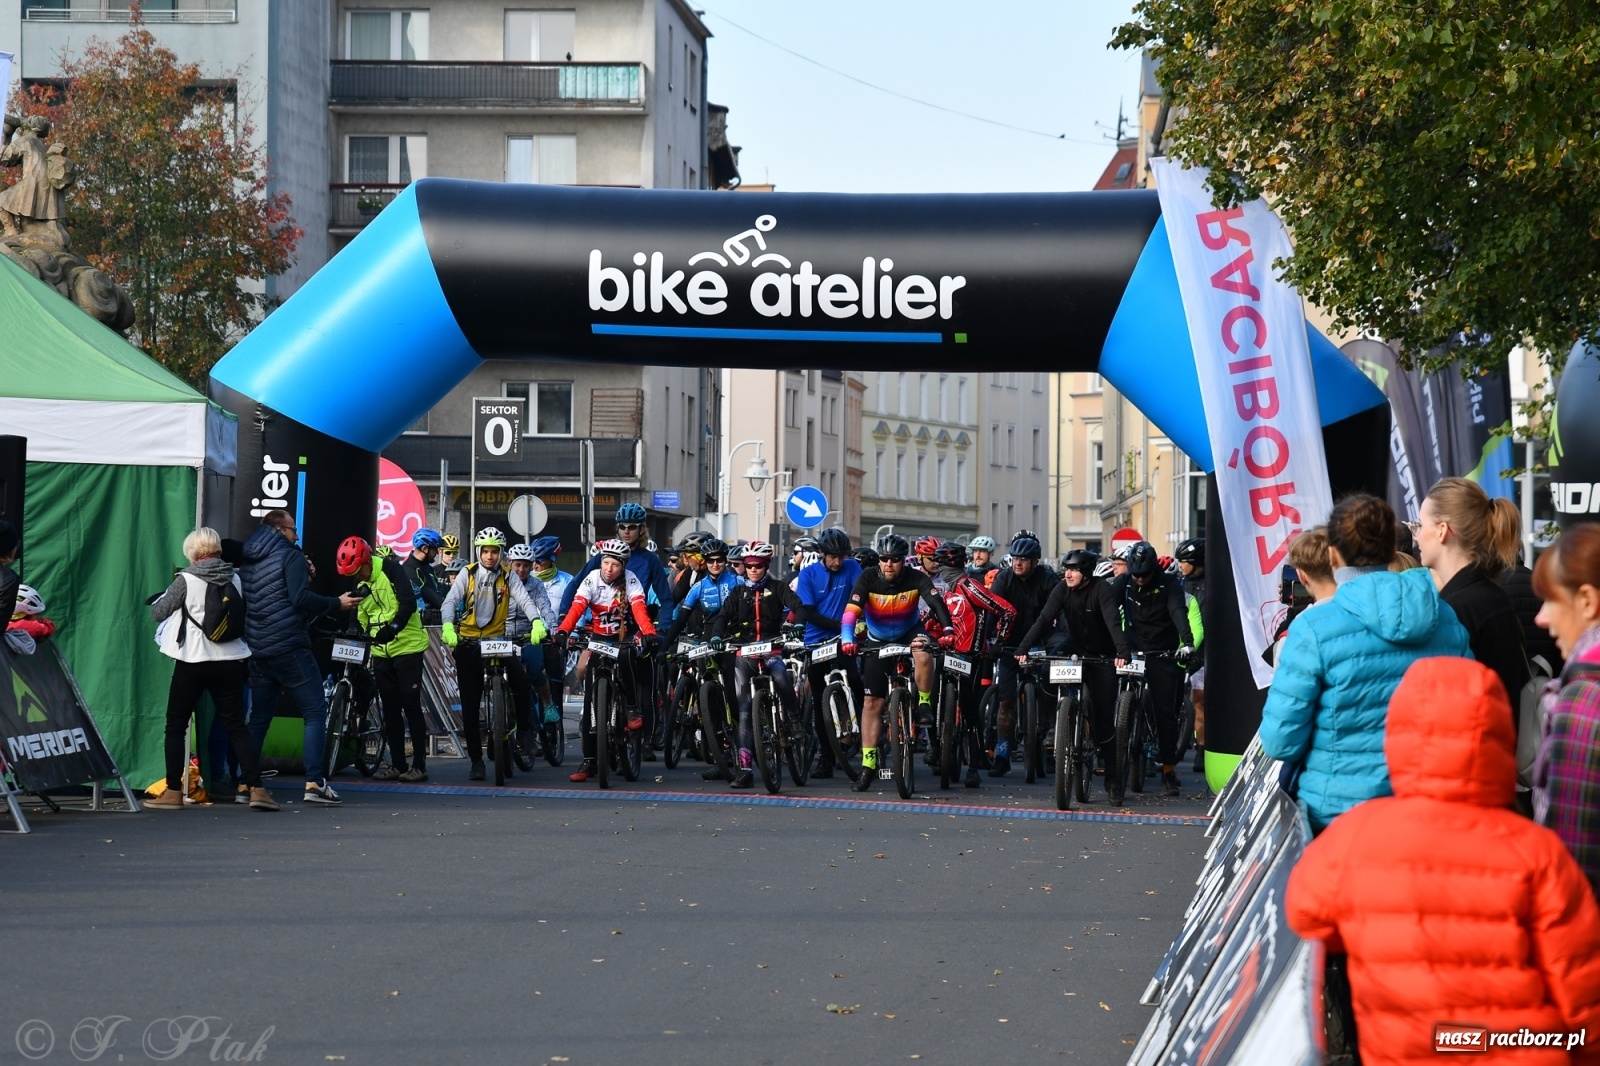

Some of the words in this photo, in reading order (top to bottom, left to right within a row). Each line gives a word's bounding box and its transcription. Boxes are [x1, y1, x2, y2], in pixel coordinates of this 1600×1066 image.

[588, 248, 728, 316] bike
[749, 255, 967, 320] atelier
[480, 405, 518, 415] SEKTOR
[484, 416, 513, 456] 0
[486, 642, 508, 651] 2479
[747, 645, 768, 653] 3247
[338, 647, 360, 658] 3182
[816, 647, 834, 657] 1918
[949, 659, 967, 670] 1083
[1055, 668, 1077, 676] 2692
[7, 727, 91, 762] MERIDA
